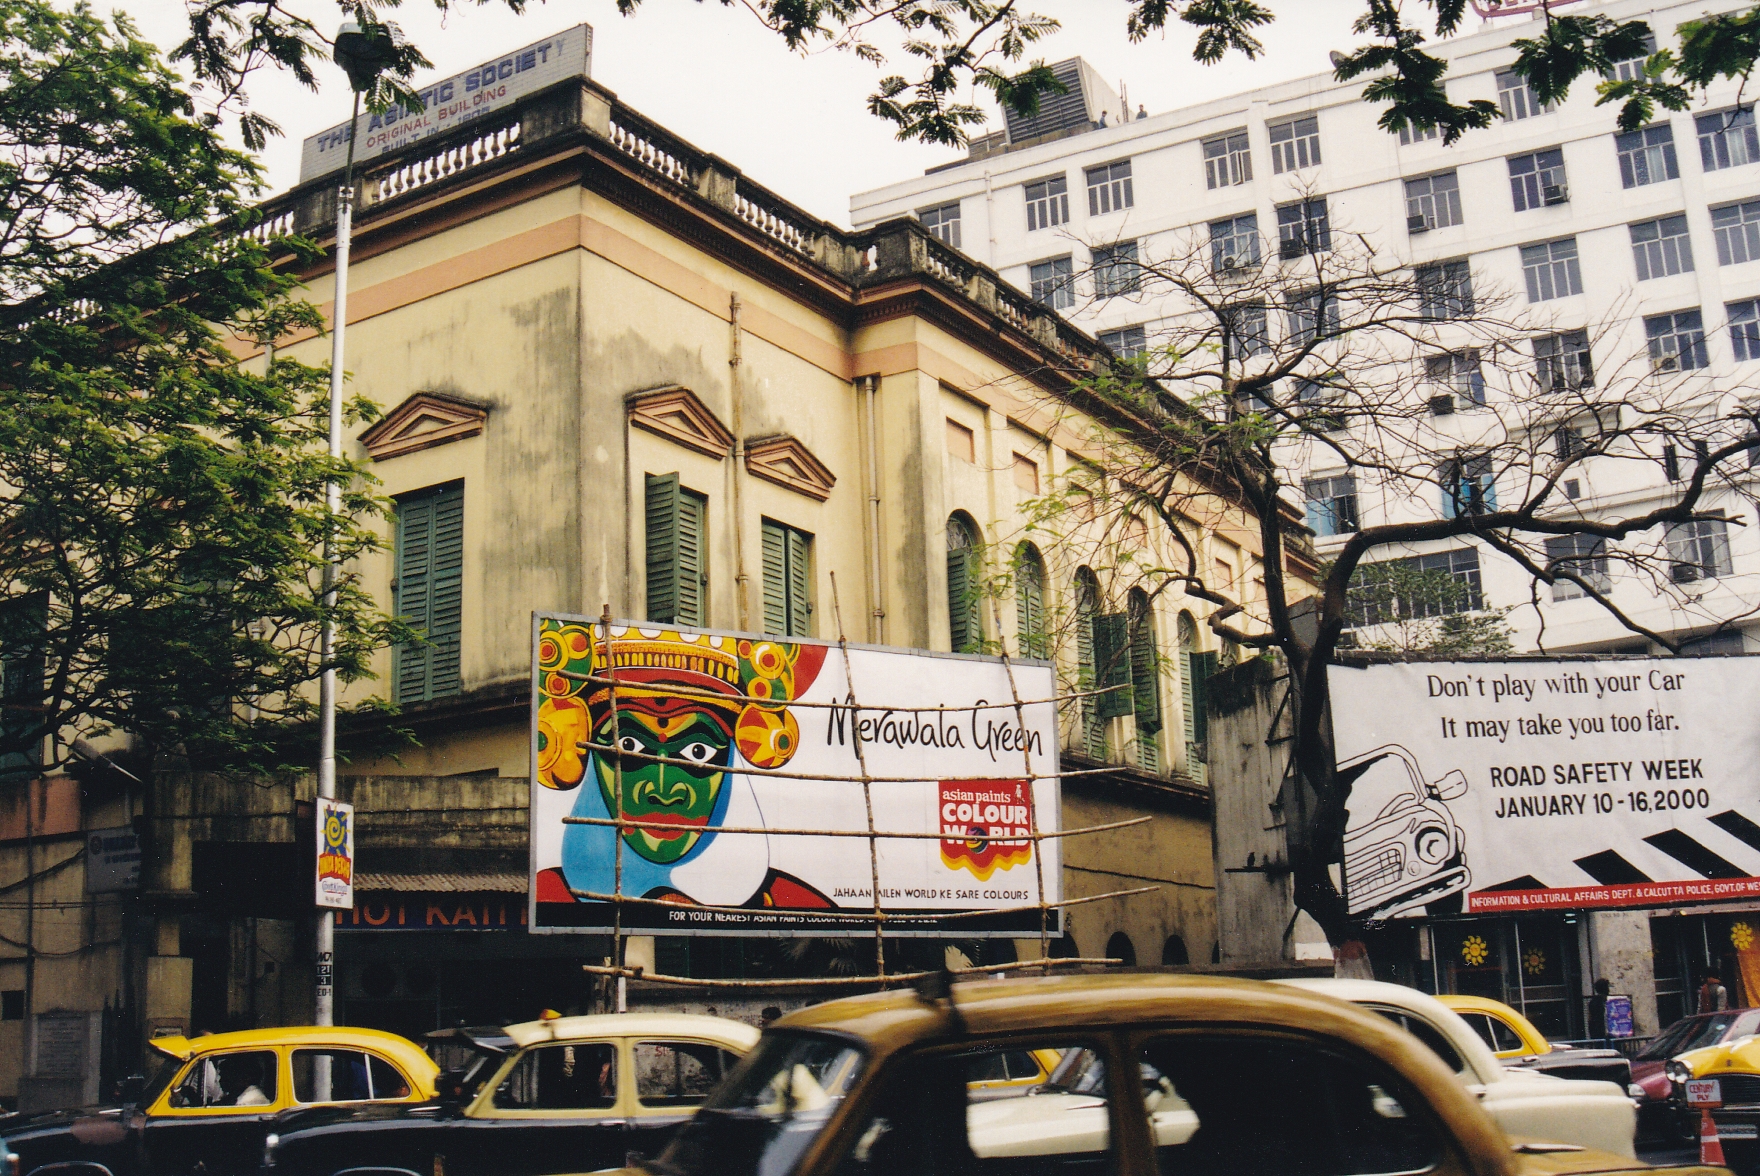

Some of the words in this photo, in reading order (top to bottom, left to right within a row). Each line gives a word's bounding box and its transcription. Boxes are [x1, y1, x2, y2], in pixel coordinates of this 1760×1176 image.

[368, 82, 453, 132] ASITIC
[465, 38, 566, 92] SOCIETY
[366, 116, 431, 148] ORIGINAL
[438, 85, 506, 120] BUILDING
[1427, 674, 1485, 697] Don't
[1492, 673, 1536, 703] play
[1544, 672, 1588, 694] with
[1594, 675, 1641, 699] your
[1649, 670, 1685, 690] Car
[827, 692, 965, 760] Merawala
[972, 699, 1042, 762] Green
[1441, 716, 1457, 738] It
[1466, 719, 1510, 743] may
[1517, 713, 1562, 735] take
[1568, 717, 1605, 740] you
[1611, 713, 1642, 732] too
[1646, 709, 1680, 732] far.
[1490, 765, 1546, 787] ROAD
[1553, 761, 1632, 785] SAFETY
[1641, 758, 1703, 781] WEEK
[942, 789, 974, 801] asian
[975, 790, 1011, 804] paints
[1495, 794, 1586, 818] JANUARY
[1593, 792, 1613, 814] 10
[942, 802, 1028, 825] COLOUR
[833, 887, 871, 898] JAHAAN
[904, 889, 937, 898] WORLD
[939, 889, 951, 899] KE
[956, 890, 979, 899] SARE
[983, 890, 1029, 899] COLOURS
[1471, 895, 1521, 907] INFORMATION
[1522, 894, 1529, 905] &
[1530, 893, 1572, 904] CULTURAL
[1574, 890, 1609, 901] AFFAIRS
[1612, 888, 1635, 899] DEPT.
[1636, 888, 1643, 897] &
[1644, 886, 1684, 897] CALCUTTA
[1686, 884, 1714, 895] POLICE,
[669, 911, 685, 921] FOR
[688, 911, 712, 922] YOUR
[1689, 1083, 1713, 1093] CENTURY
